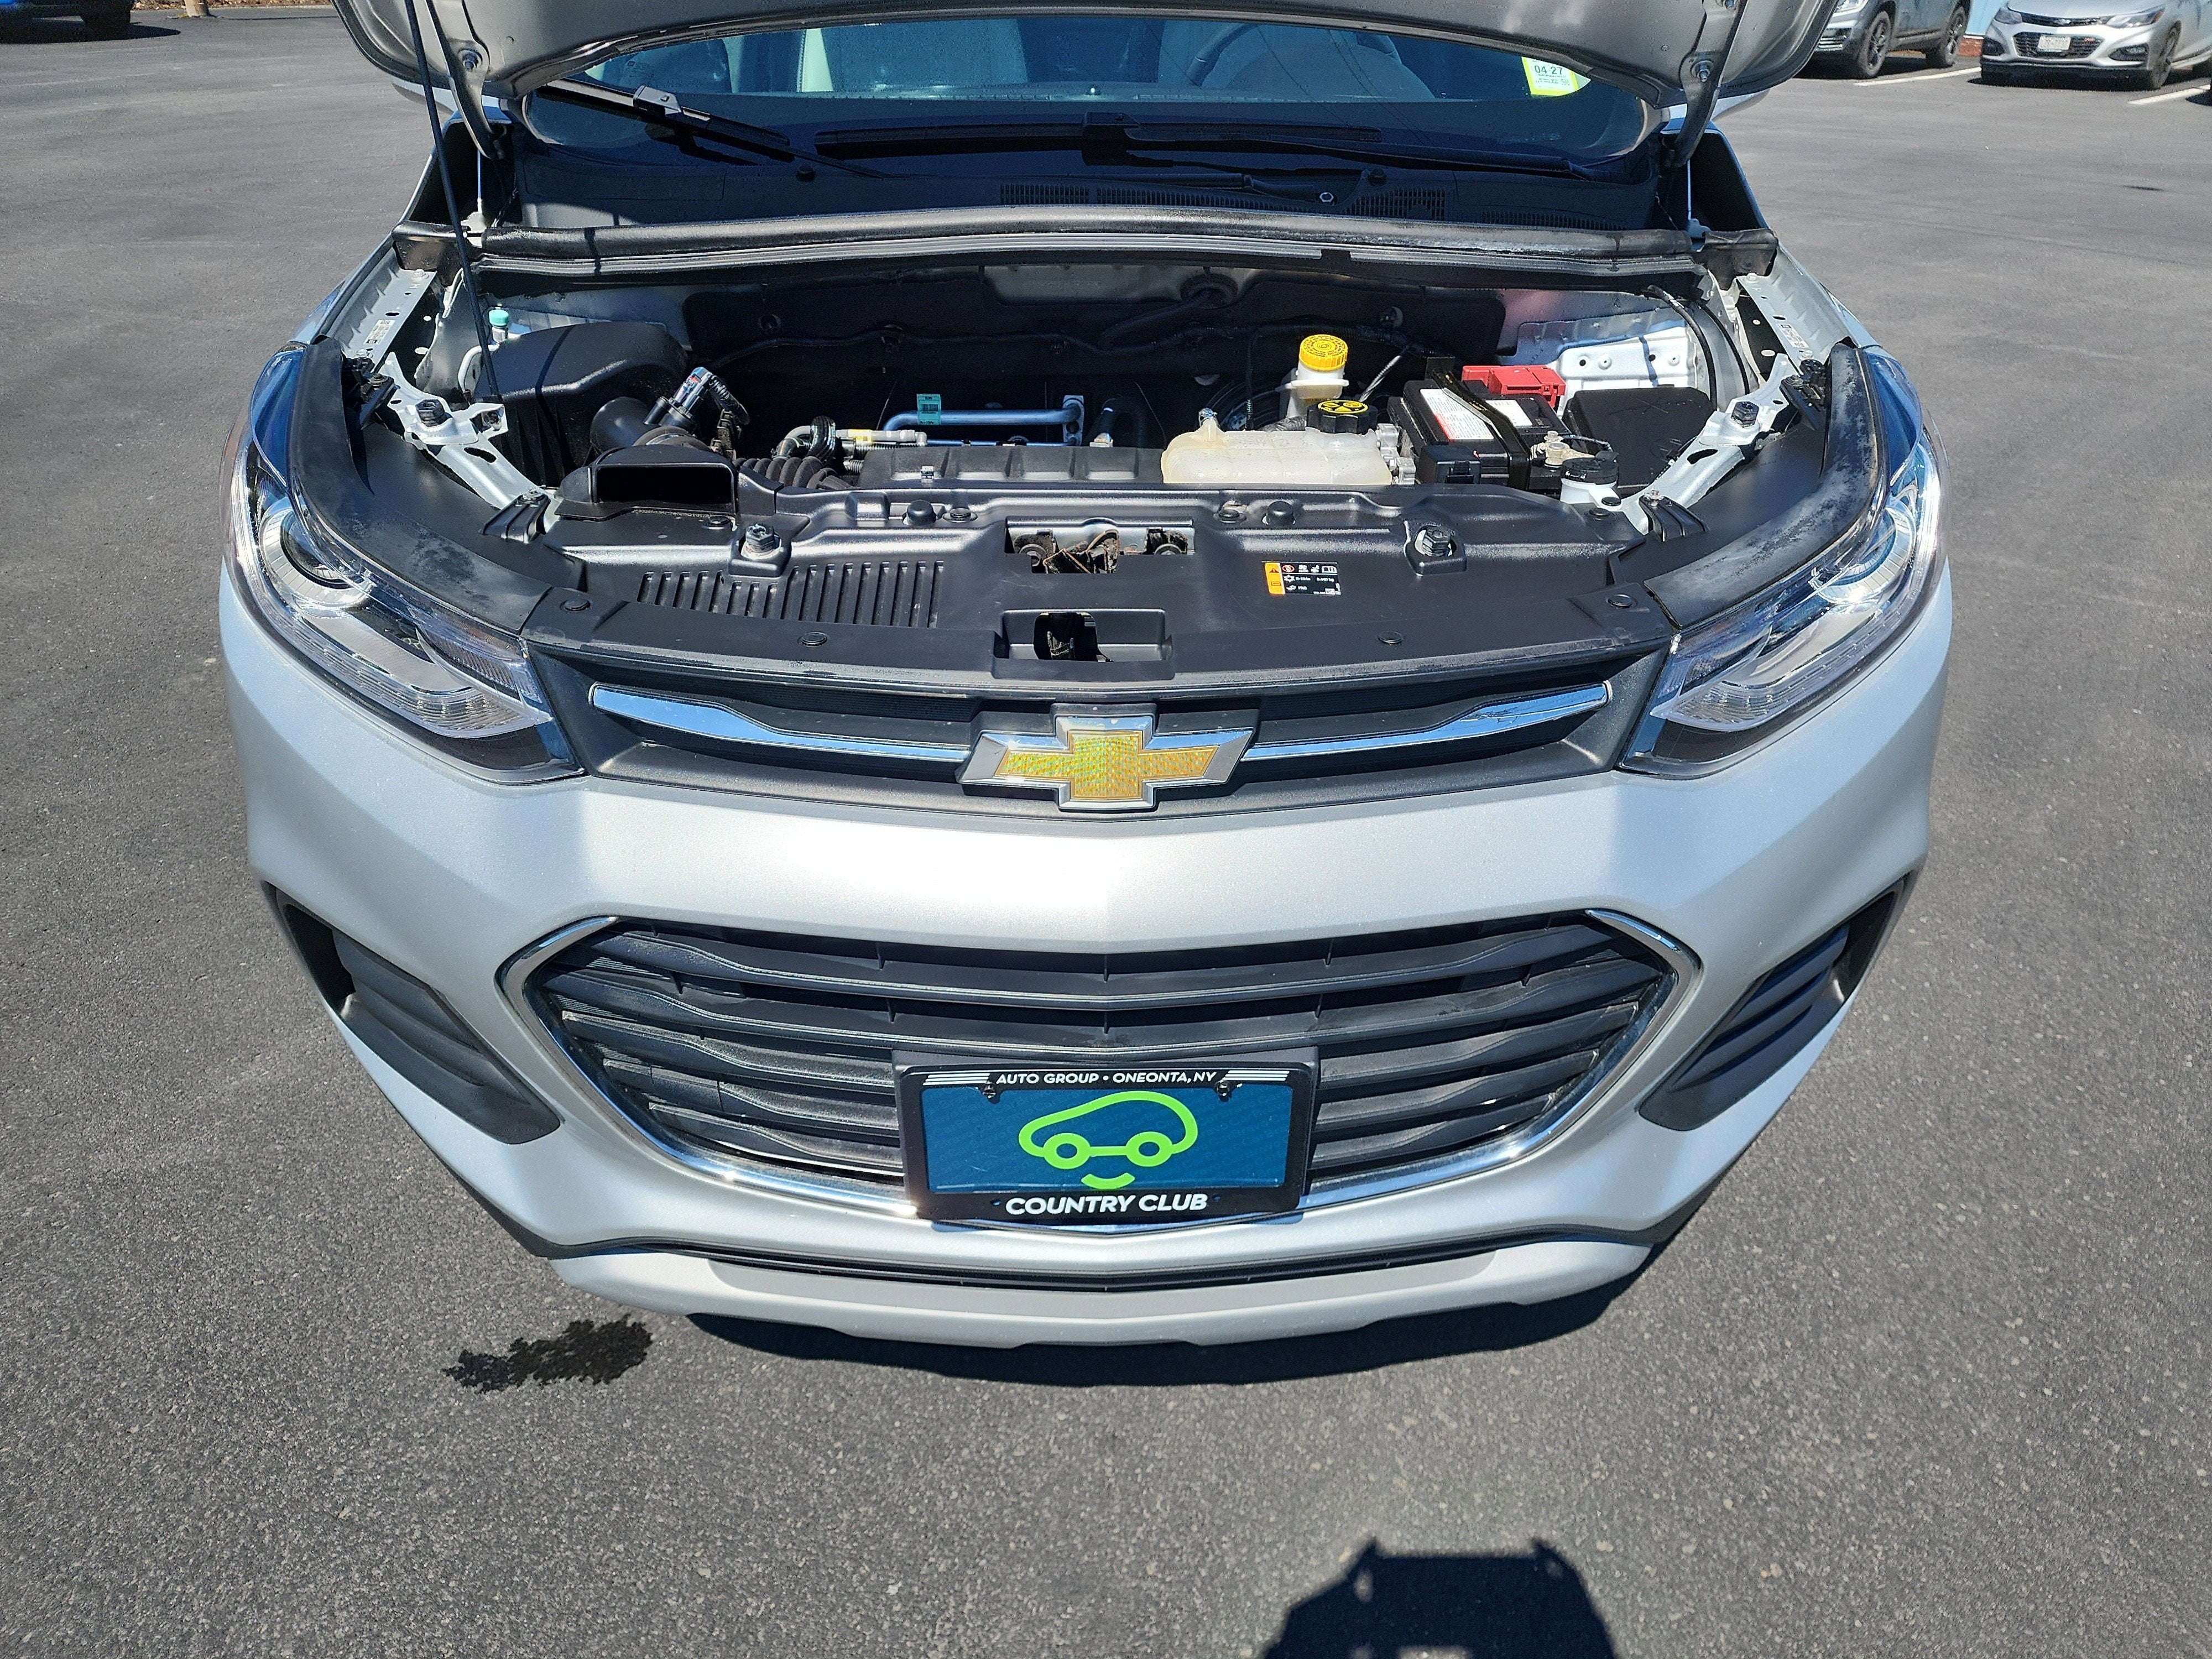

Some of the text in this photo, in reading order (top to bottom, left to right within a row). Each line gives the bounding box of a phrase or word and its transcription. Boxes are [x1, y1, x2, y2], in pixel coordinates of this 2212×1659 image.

[996, 1071, 1217, 1084] AUTO GROUP ONEONTA, NY
[1005, 1193, 1208, 1215] COUNTRY CLUB
